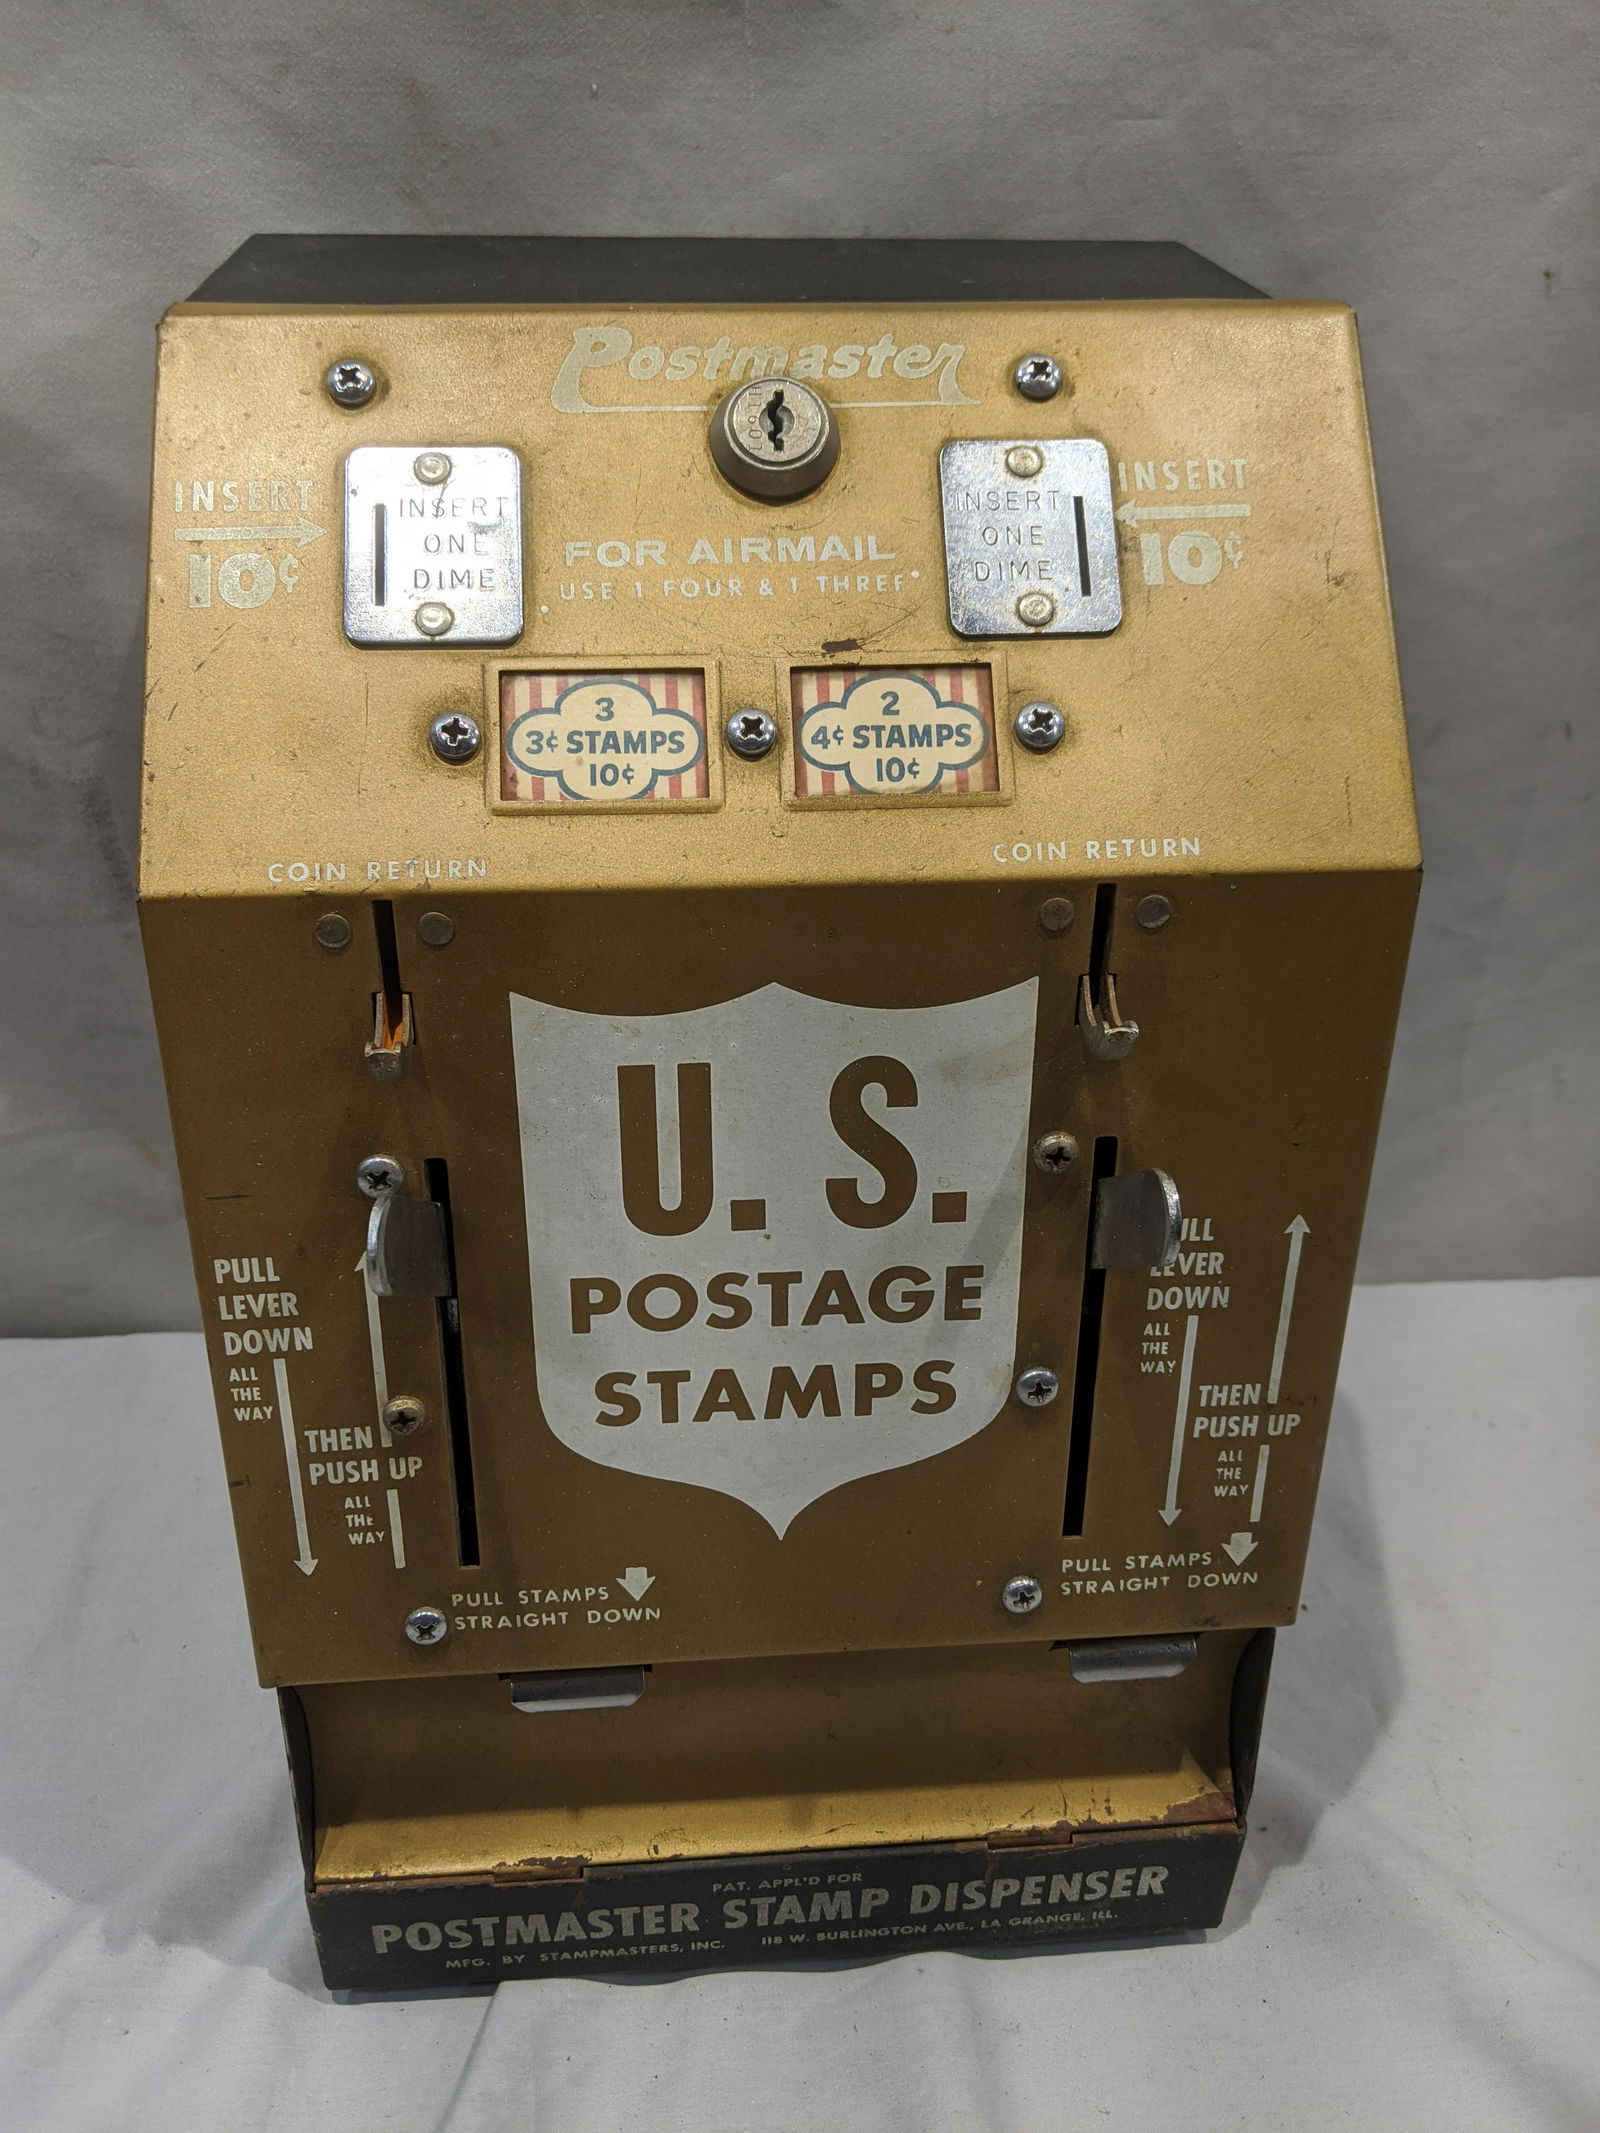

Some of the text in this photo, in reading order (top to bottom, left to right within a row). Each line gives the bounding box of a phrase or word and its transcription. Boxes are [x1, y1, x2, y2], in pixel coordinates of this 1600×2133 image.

[551, 326, 981, 414] Postmaster
[1118, 458, 1247, 491] INSERT
[174, 480, 314, 512] INSERT
[400, 497, 509, 519] INSERT
[956, 490, 1061, 510] INSERT
[424, 535, 487, 555] ONE
[982, 526, 1044, 547] ONE
[565, 535, 896, 568] FOR AIRMAIL
[1139, 529, 1244, 586] 10¢
[188, 552, 300, 610] 10¢
[413, 567, 494, 592] DIME
[974, 560, 1052, 582] DIME
[560, 582, 612, 600] USE
[663, 578, 743, 597] FOUR
[758, 577, 774, 597] &
[595, 697, 614, 722] 3
[881, 691, 900, 716] 2
[525, 730, 685, 755] 3¢ STAMPS
[810, 724, 972, 750] 4¢ STAMPS
[589, 764, 634, 787] 10¢
[876, 757, 920, 783] 10¢
[993, 837, 1200, 863] COIN RETURN
[268, 859, 486, 882] COIN RETURN
[617, 1055, 968, 1236] U. S.
[1180, 1218, 1214, 1241] LL
[214, 1257, 280, 1284] PULL
[218, 1292, 299, 1320] LEVER
[569, 1265, 985, 1334] POSTAGE
[1146, 1286, 1230, 1310] DOWN
[223, 1326, 314, 1356] DOWN
[1144, 1323, 1170, 1336] ALL
[1142, 1342, 1168, 1355] THE
[229, 1368, 258, 1382] ALL
[1140, 1360, 1176, 1373] WAY
[231, 1387, 261, 1401] THE
[594, 1360, 957, 1427] STAMPS
[1199, 1383, 1261, 1407] THEN
[234, 1406, 273, 1421] WAY
[1193, 1414, 1301, 1438] PUSH UP
[304, 1426, 373, 1453] THEN
[1218, 1450, 1243, 1462] ALL
[308, 1456, 423, 1485] PUSH UP
[1216, 1467, 1242, 1480] THE
[344, 1496, 371, 1509] ALL
[1214, 1484, 1249, 1497] WAY
[346, 1514, 374, 1527] THE
[348, 1531, 385, 1545] WAY
[1061, 1551, 1213, 1573] PULL STAMPS
[1061, 1571, 1258, 1595] STRAIGHT DOWN
[452, 1586, 609, 1607] PULL STAMPS
[454, 1607, 661, 1630] STRAIGHT DOWN
[712, 1872, 862, 1892] PAT. APPL'D FOR
[371, 1865, 1169, 1954] POSTMASTER STAMP DISPENSER
[761, 1937, 783, 1945] 118
[789, 1934, 811, 1944] W.
[816, 1924, 927, 1941] BURLINGTON
[981, 1919, 1001, 1929] LA
[1008, 1912, 1086, 1926] GRANGE,
[445, 1940, 726, 1968] MFG. BY STAMPMASTERS, INC.
